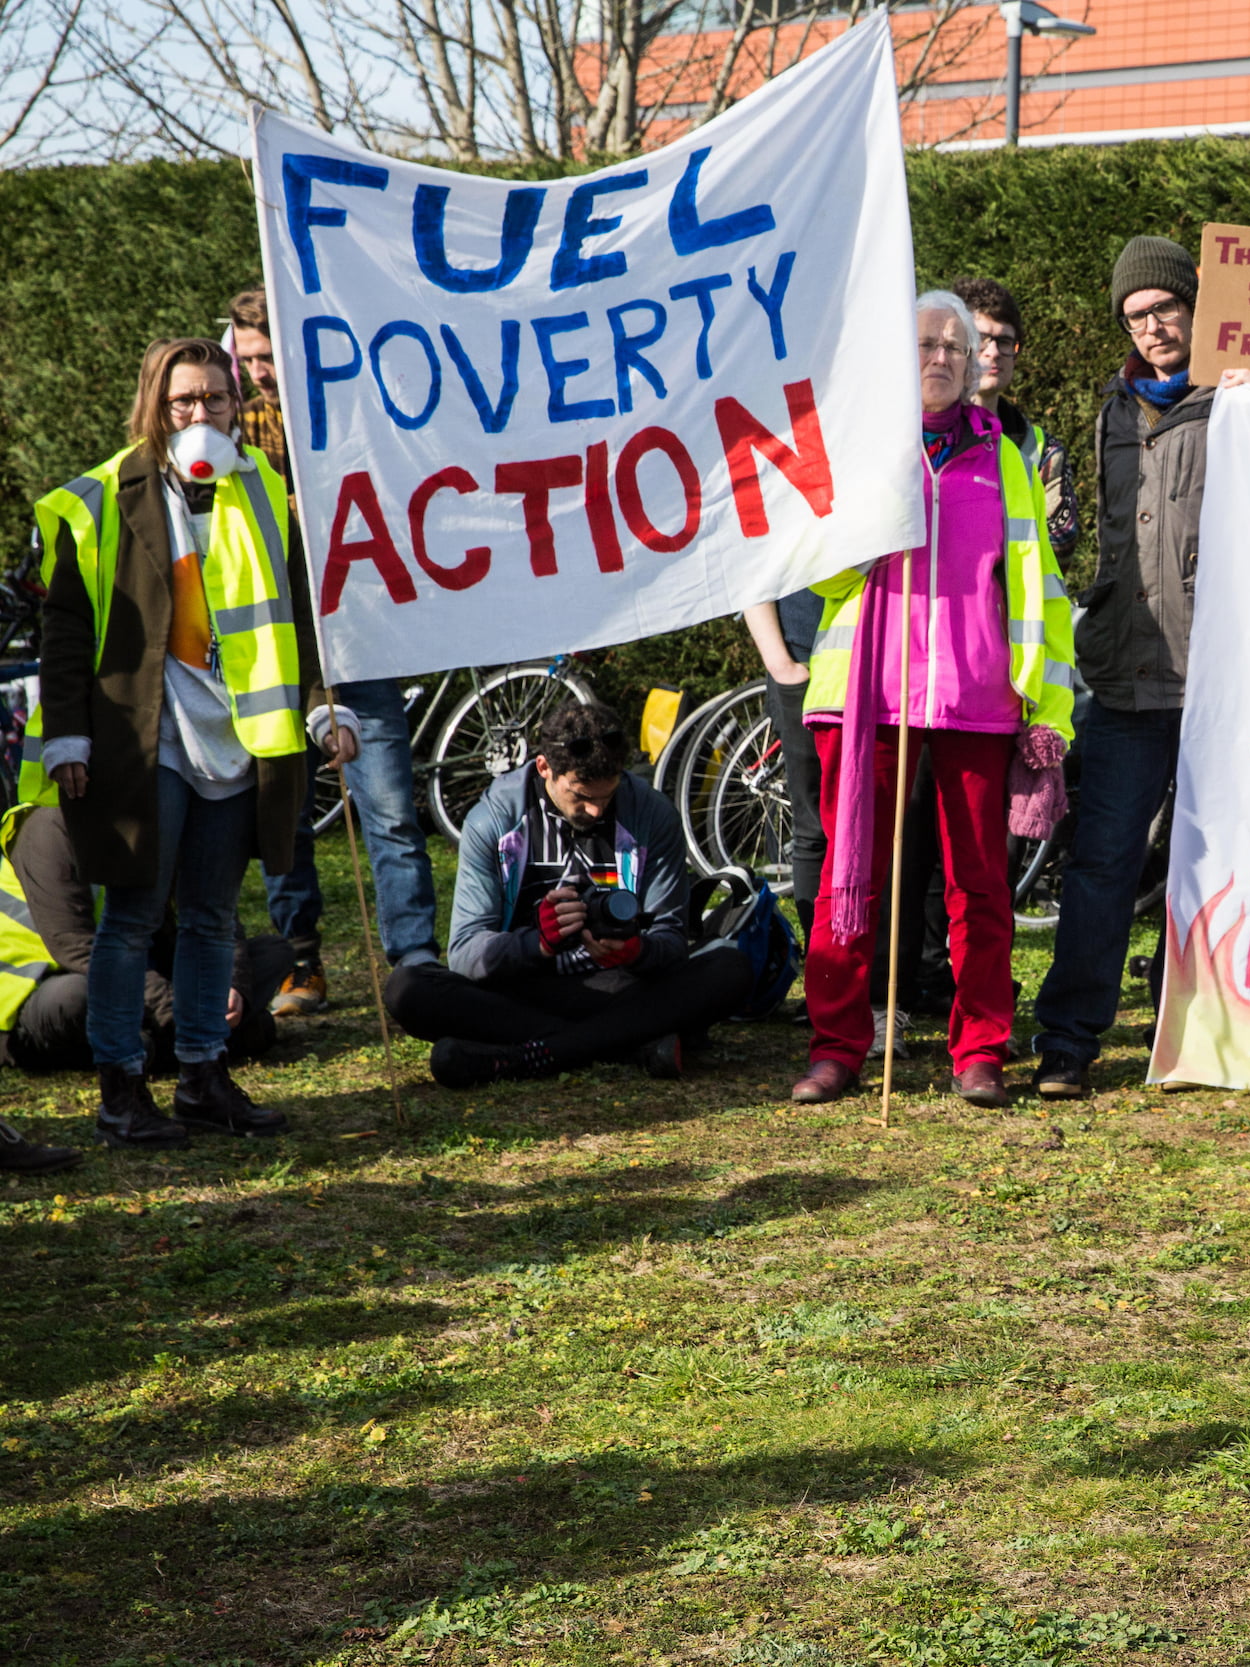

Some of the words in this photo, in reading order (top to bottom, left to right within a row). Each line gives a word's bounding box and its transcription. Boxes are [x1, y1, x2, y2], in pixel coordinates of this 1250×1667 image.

[282, 146, 776, 295] FUEL
[303, 250, 797, 451] POVERTY
[321, 378, 834, 616] ACTION
